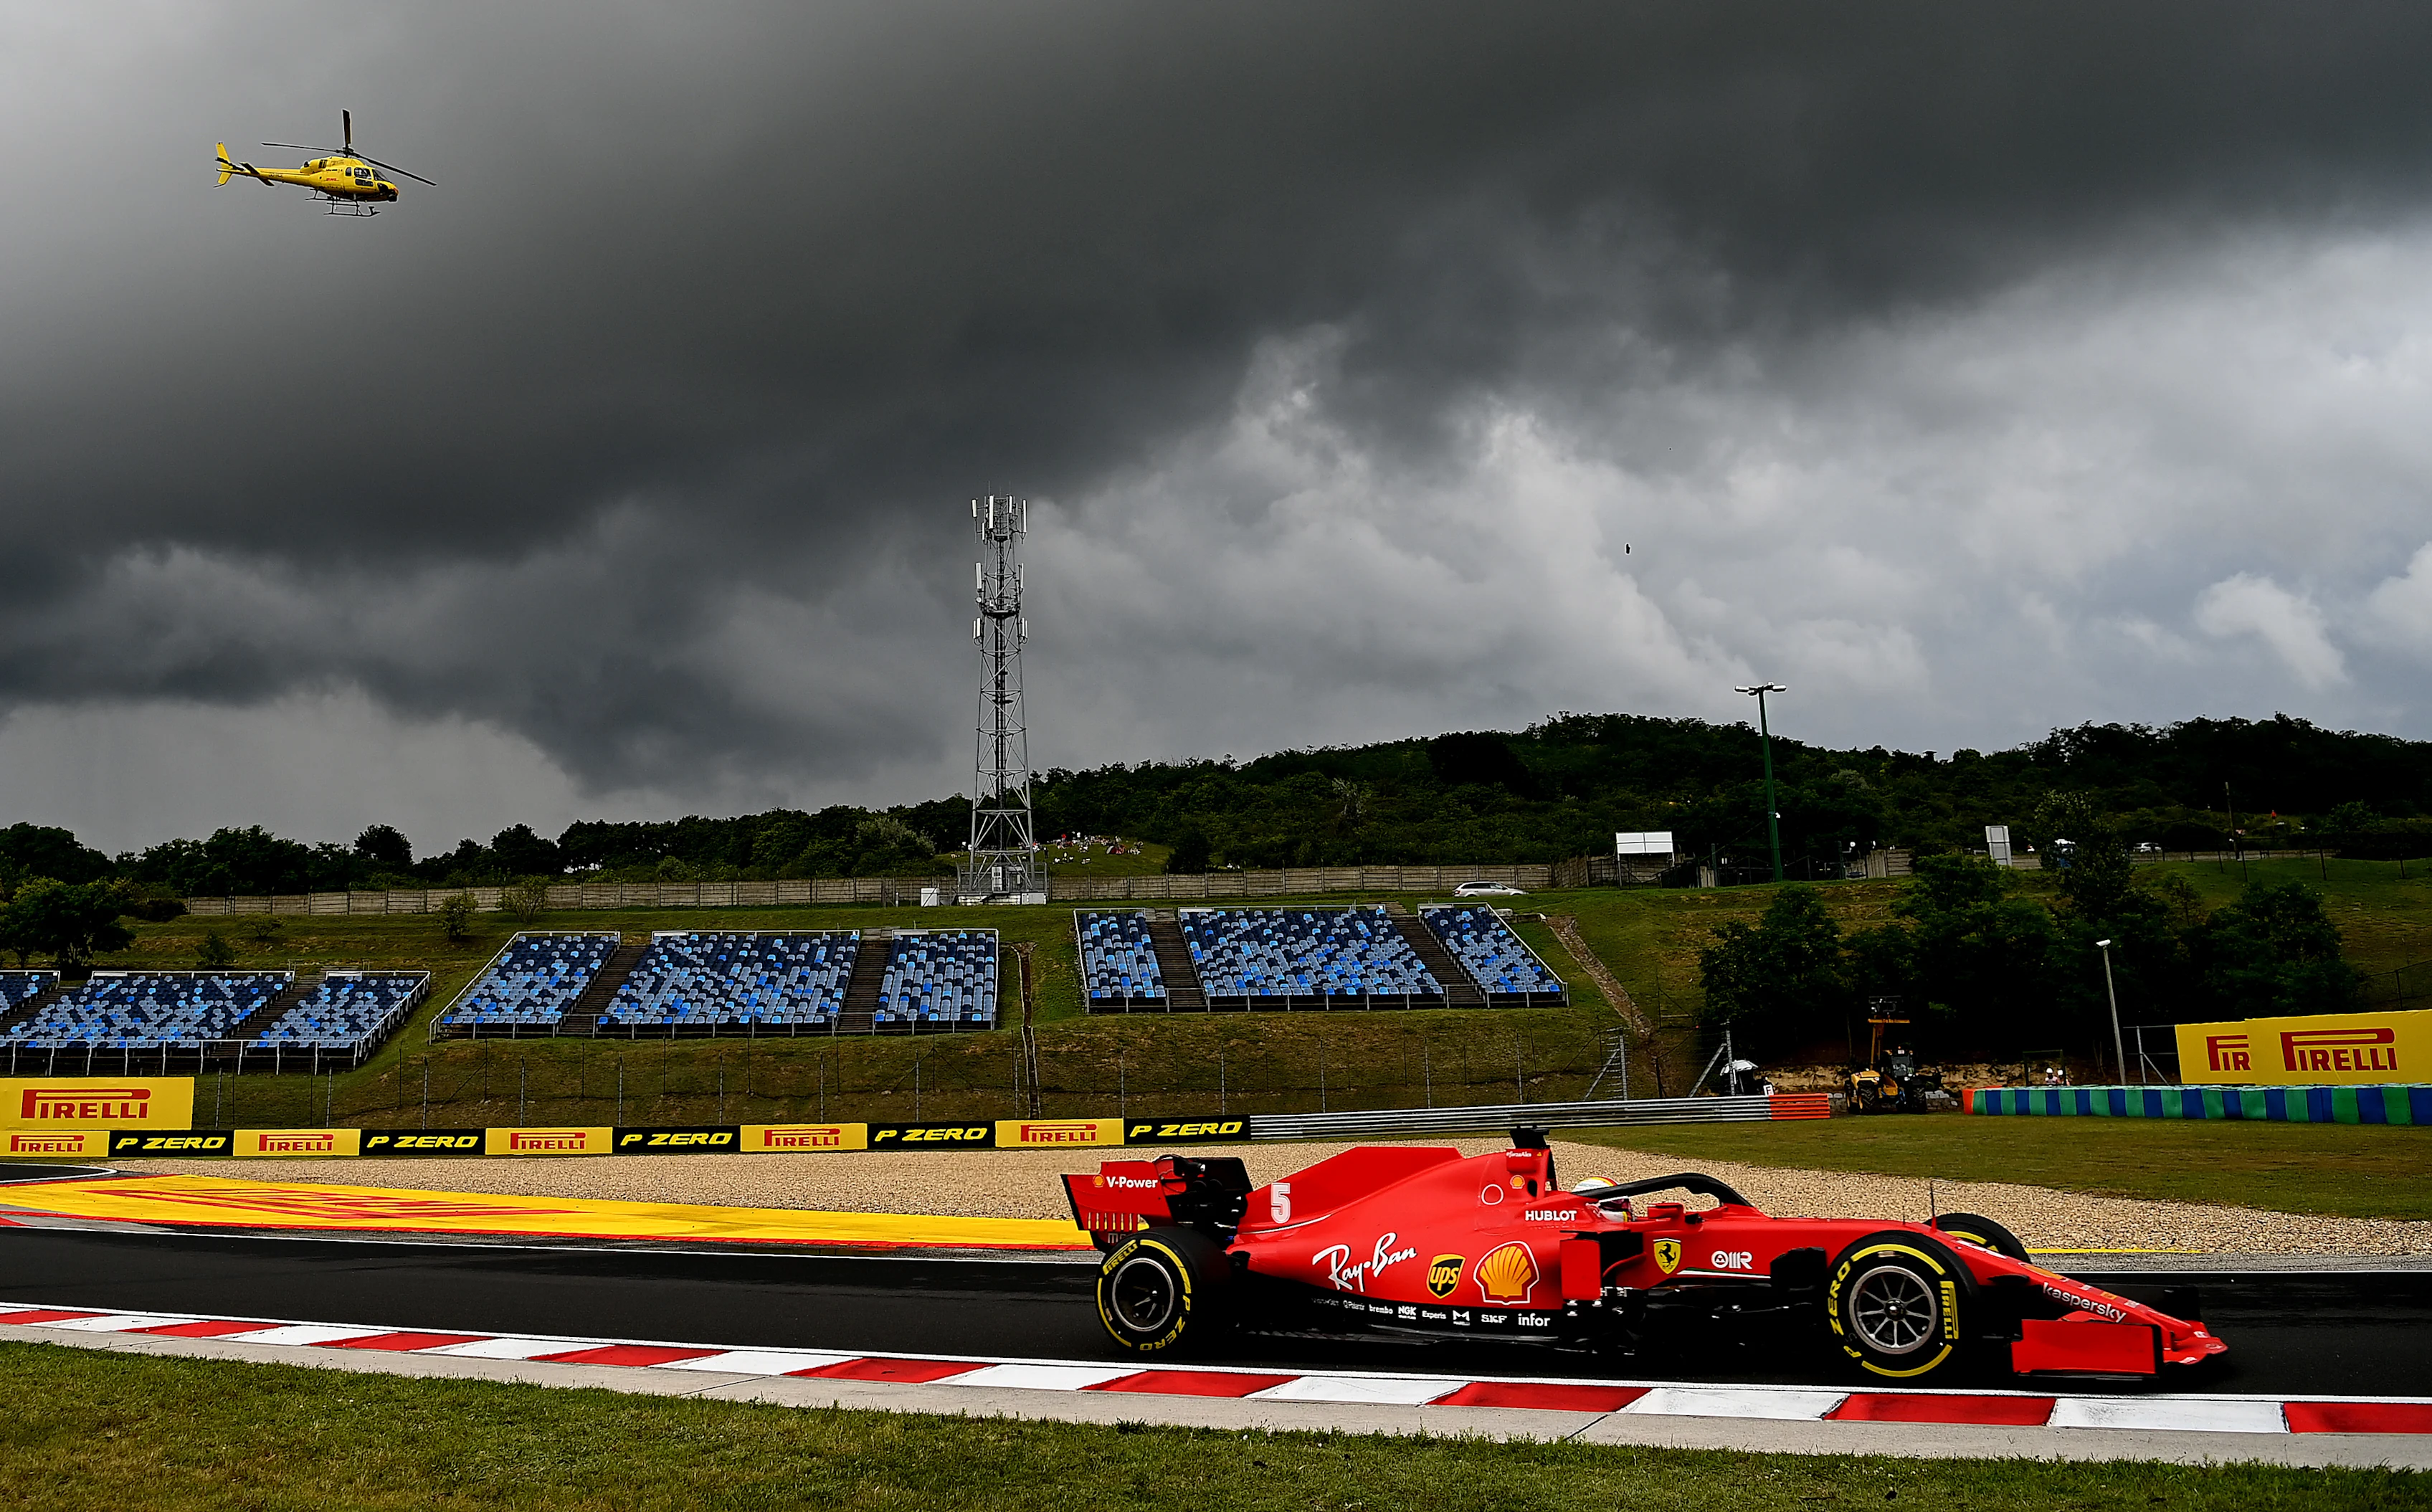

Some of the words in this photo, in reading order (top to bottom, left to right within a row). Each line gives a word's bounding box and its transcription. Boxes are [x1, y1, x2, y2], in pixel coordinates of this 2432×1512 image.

[2280, 1027, 2398, 1070] PIRELLI
[21, 1088, 151, 1118] PIRELLI
[764, 1128, 841, 1146] PIRELLI
[874, 1130, 898, 1142] P
[902, 1127, 988, 1141] ZERO
[1020, 1123, 1098, 1143] PIRELLI
[1130, 1125, 1152, 1138] P
[1158, 1121, 1243, 1136] ZERO
[10, 1135, 85, 1152] PIRELLI
[115, 1137, 139, 1149] P
[143, 1136, 227, 1149] ZERO
[259, 1134, 334, 1151] PIRELLI
[367, 1136, 390, 1148] P
[393, 1136, 479, 1149] ZERO
[510, 1132, 586, 1150] PIRELLI
[619, 1134, 643, 1146] P
[648, 1132, 733, 1146] ZERO
[1106, 1176, 1159, 1189] V-Power
[1270, 1181, 1291, 1224] 5
[1524, 1209, 1577, 1222] HUBLOT
[1102, 1239, 1139, 1275] PIRELLI
[1429, 1266, 1460, 1291] ups
[1182, 1295, 1192, 1312] P
[1828, 1260, 1852, 1336] ZERO
[2043, 1281, 2127, 1323] kaspersky
[1369, 1304, 1394, 1315] brembo
[1397, 1306, 1417, 1316] NGK
[1939, 1280, 1960, 1340] PIRELLI
[1481, 1314, 1508, 1323] SKF
[1517, 1313, 1551, 1327] infor
[1139, 1316, 1186, 1351] ZERO
[1843, 1345, 1862, 1358] P
